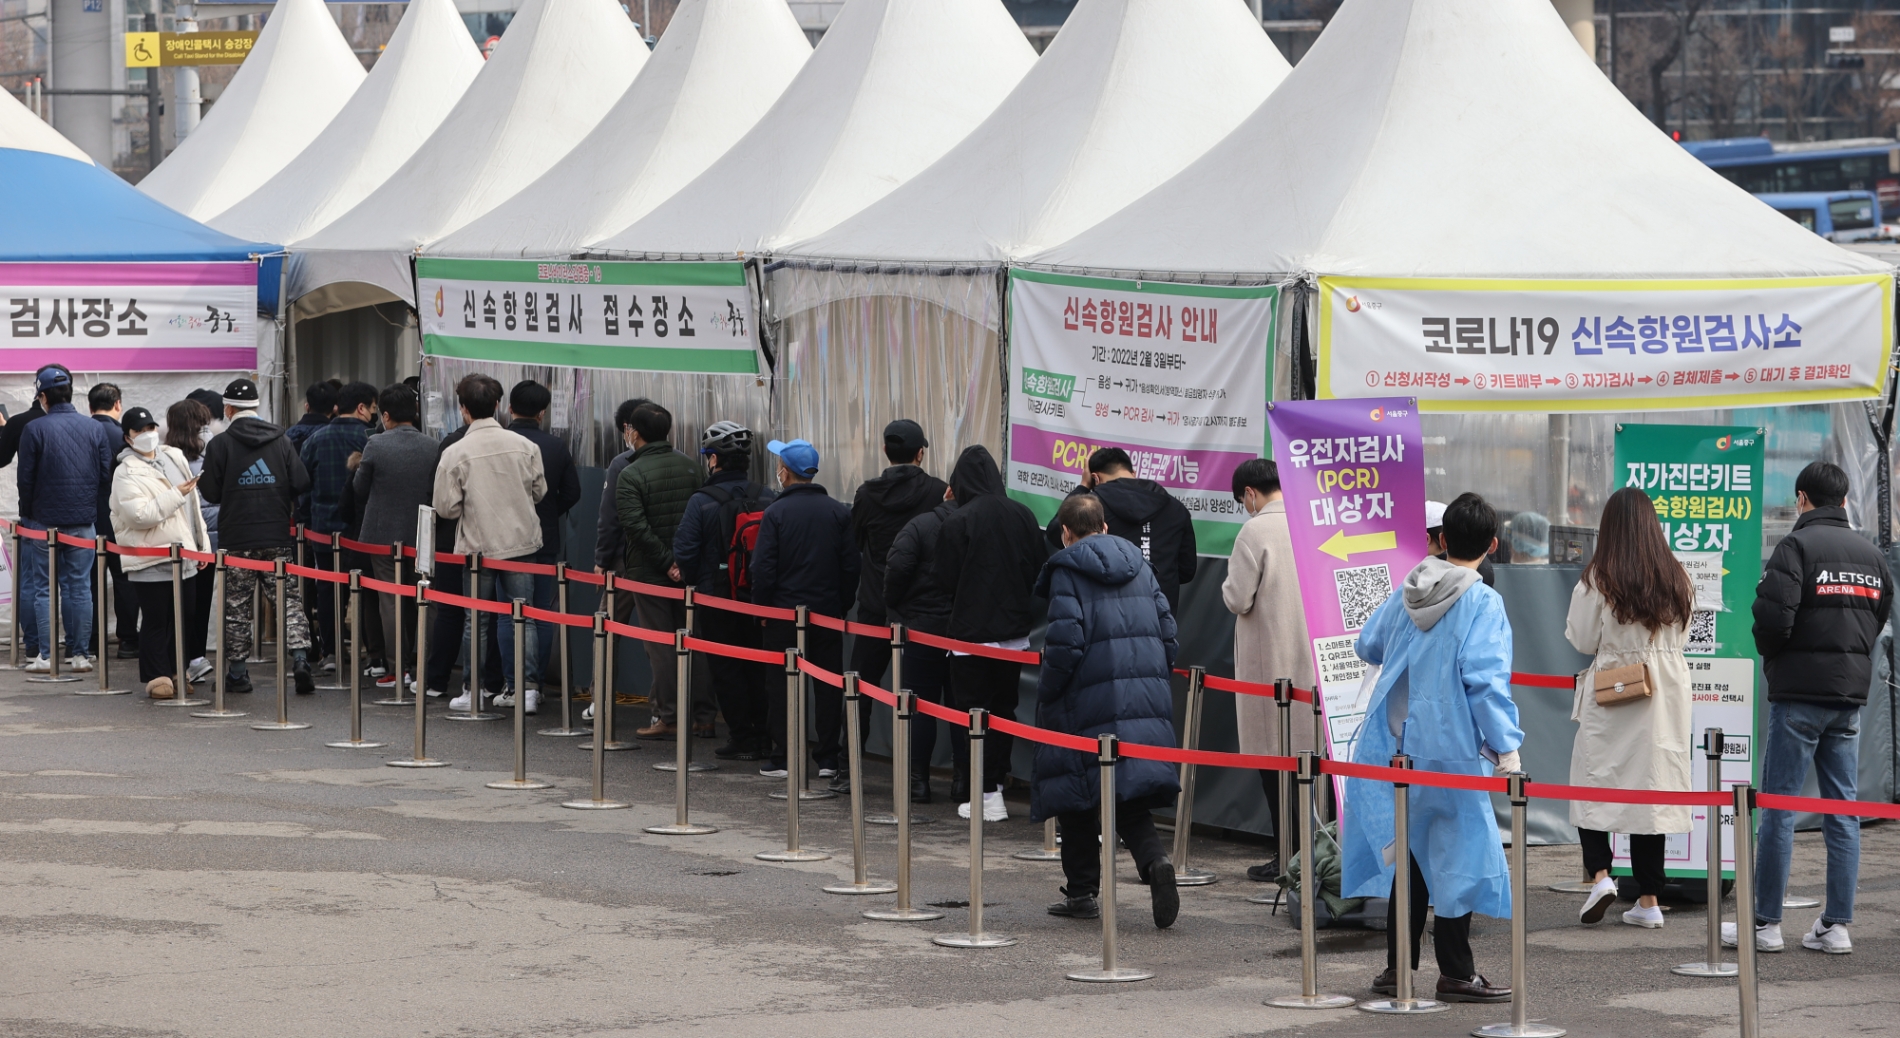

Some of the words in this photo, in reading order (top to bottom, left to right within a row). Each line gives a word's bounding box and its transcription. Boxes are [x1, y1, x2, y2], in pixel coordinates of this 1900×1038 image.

[166, 39, 221, 51] 장애인콜택시
[224, 38, 253, 50] 승강장
[10, 298, 148, 338] 검사장소
[204, 305, 236, 333] 중구
[464, 289, 583, 334] 신속항원검사
[603, 294, 696, 338] 접수장소
[1063, 296, 1172, 340] 신속항원검사
[1181, 306, 1218, 344] 안내
[1422, 316, 1559, 355] 코로나19
[1571, 313, 1802, 355] 신속항원검사소
[1092, 345, 1106, 363] 기간
[1111, 347, 1138, 366] 2022년
[1139, 350, 1152, 367] 2월
[1153, 352, 1186, 370] 3일부터~
[1098, 374, 1111, 390] 음성
[1125, 378, 1138, 394] 귀가
[1384, 371, 1450, 389] 신청서작성
[1490, 373, 1542, 389] 키트배부
[1582, 372, 1635, 389] 자가검사
[1673, 369, 1723, 386] 검체제출
[1760, 367, 1785, 382] 대기
[1788, 366, 1801, 381] 후
[1804, 363, 1851, 380] 결과확인
[1095, 402, 1109, 418] 양성
[1124, 406, 1140, 422] PCR
[1141, 408, 1154, 424] 검사
[1167, 411, 1180, 427] 귀가
[1386, 410, 1408, 418] 서울중구
[1052, 439, 1088, 469] PCR
[1289, 434, 1405, 468] 유전자검사
[238, 475, 276, 485] adidas
[1171, 455, 1199, 484] 가능
[1316, 467, 1379, 494] (PCR)
[1626, 462, 1751, 491] 자가진단키트
[1210, 498, 1234, 514] 양성인
[1309, 492, 1394, 526] 대상자
[1816, 569, 1880, 587] ALETSCH
[1817, 586, 1855, 594] ARENA
[1320, 653, 1327, 662] 2.
[1328, 649, 1355, 661] QR코드
[1325, 639, 1352, 651] 스마트폰
[1322, 664, 1329, 673] 3.
[1324, 675, 1331, 683] 4.
[1332, 671, 1360, 682] 개인정보
[1696, 662, 1711, 670] 실행
[1715, 683, 1729, 691] 작성
[1722, 694, 1744, 702] 선택시
